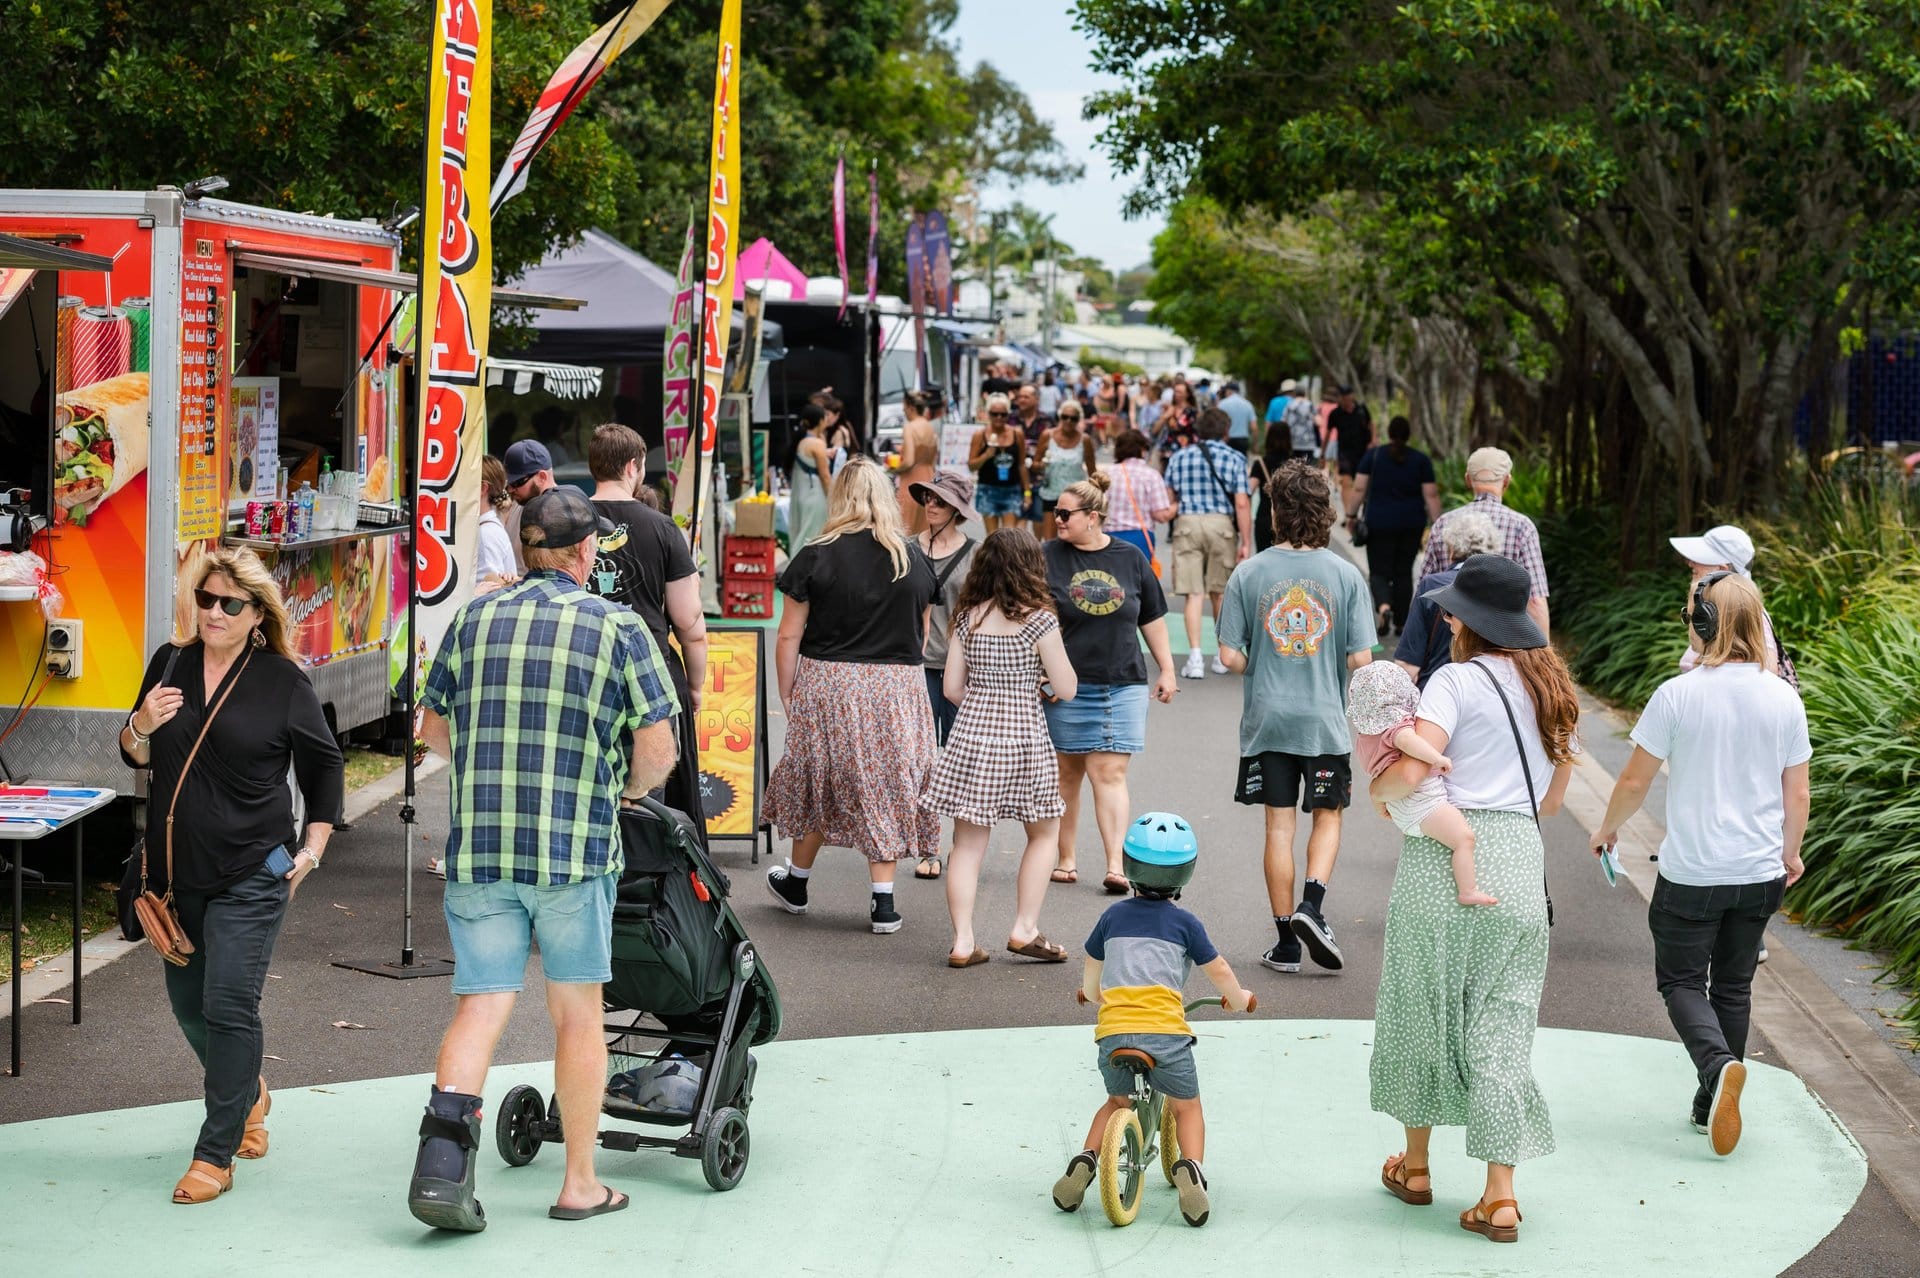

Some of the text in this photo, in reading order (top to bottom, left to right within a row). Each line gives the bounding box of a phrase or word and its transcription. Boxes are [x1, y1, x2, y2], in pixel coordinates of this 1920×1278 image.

[196, 240, 213, 257] MENU
[183, 371, 191, 387] Hot
[192, 371, 204, 389] Chips
[706, 651, 733, 693] T
[699, 708, 752, 752] PS
[699, 786, 713, 797] OX
